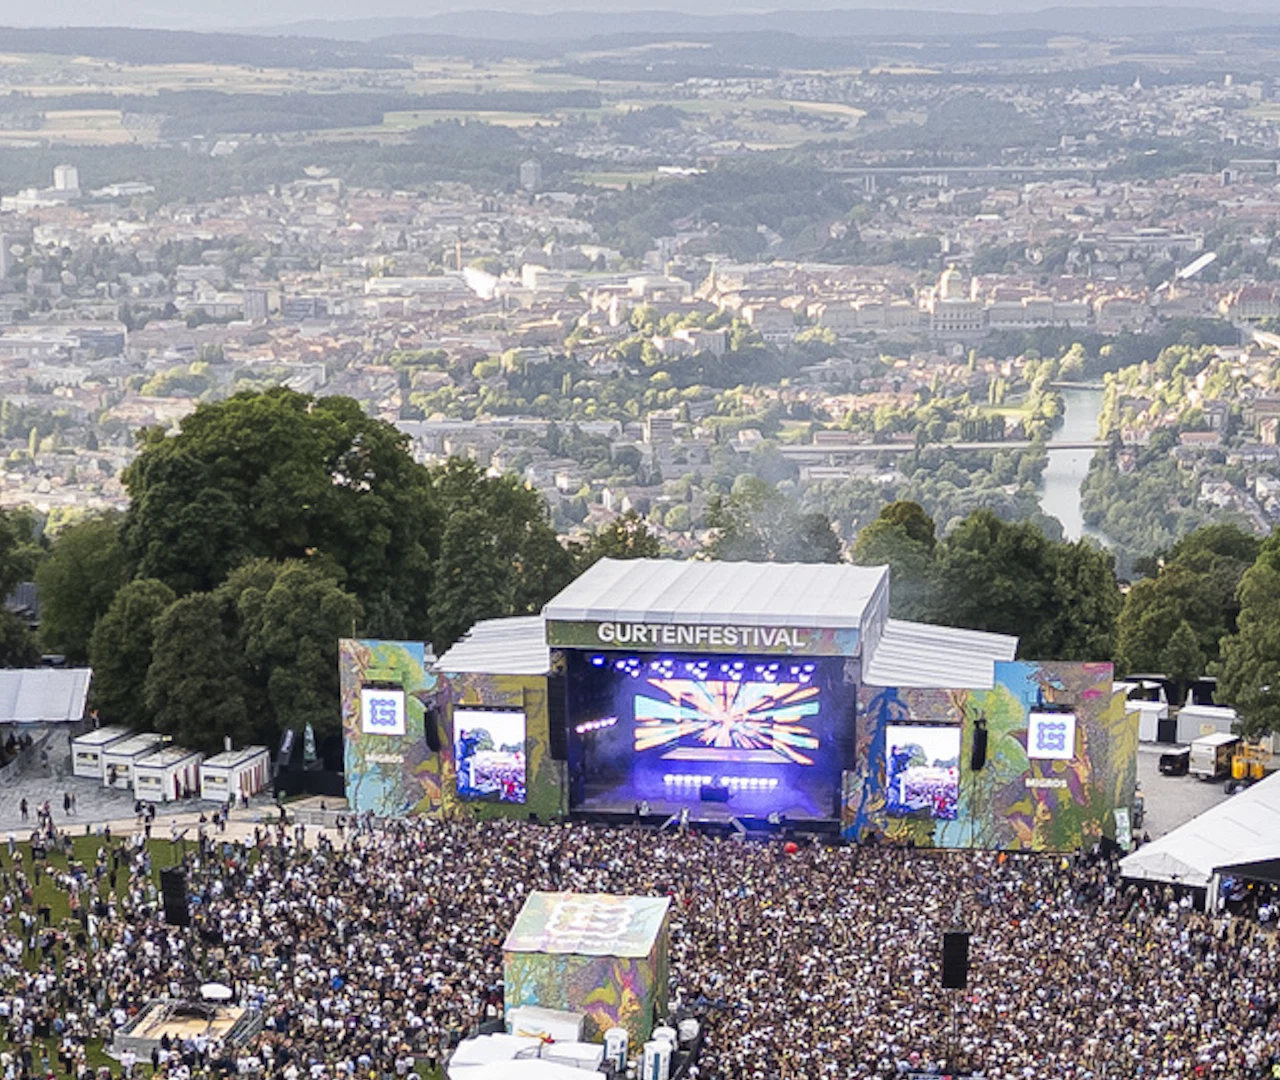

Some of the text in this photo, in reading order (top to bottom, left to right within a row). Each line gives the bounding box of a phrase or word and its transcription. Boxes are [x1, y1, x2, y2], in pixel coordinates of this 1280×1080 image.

[597, 622, 806, 647] GURTENFESTIVAL
[364, 753, 405, 764] MIGROS
[1025, 778, 1068, 788] MIGROS
